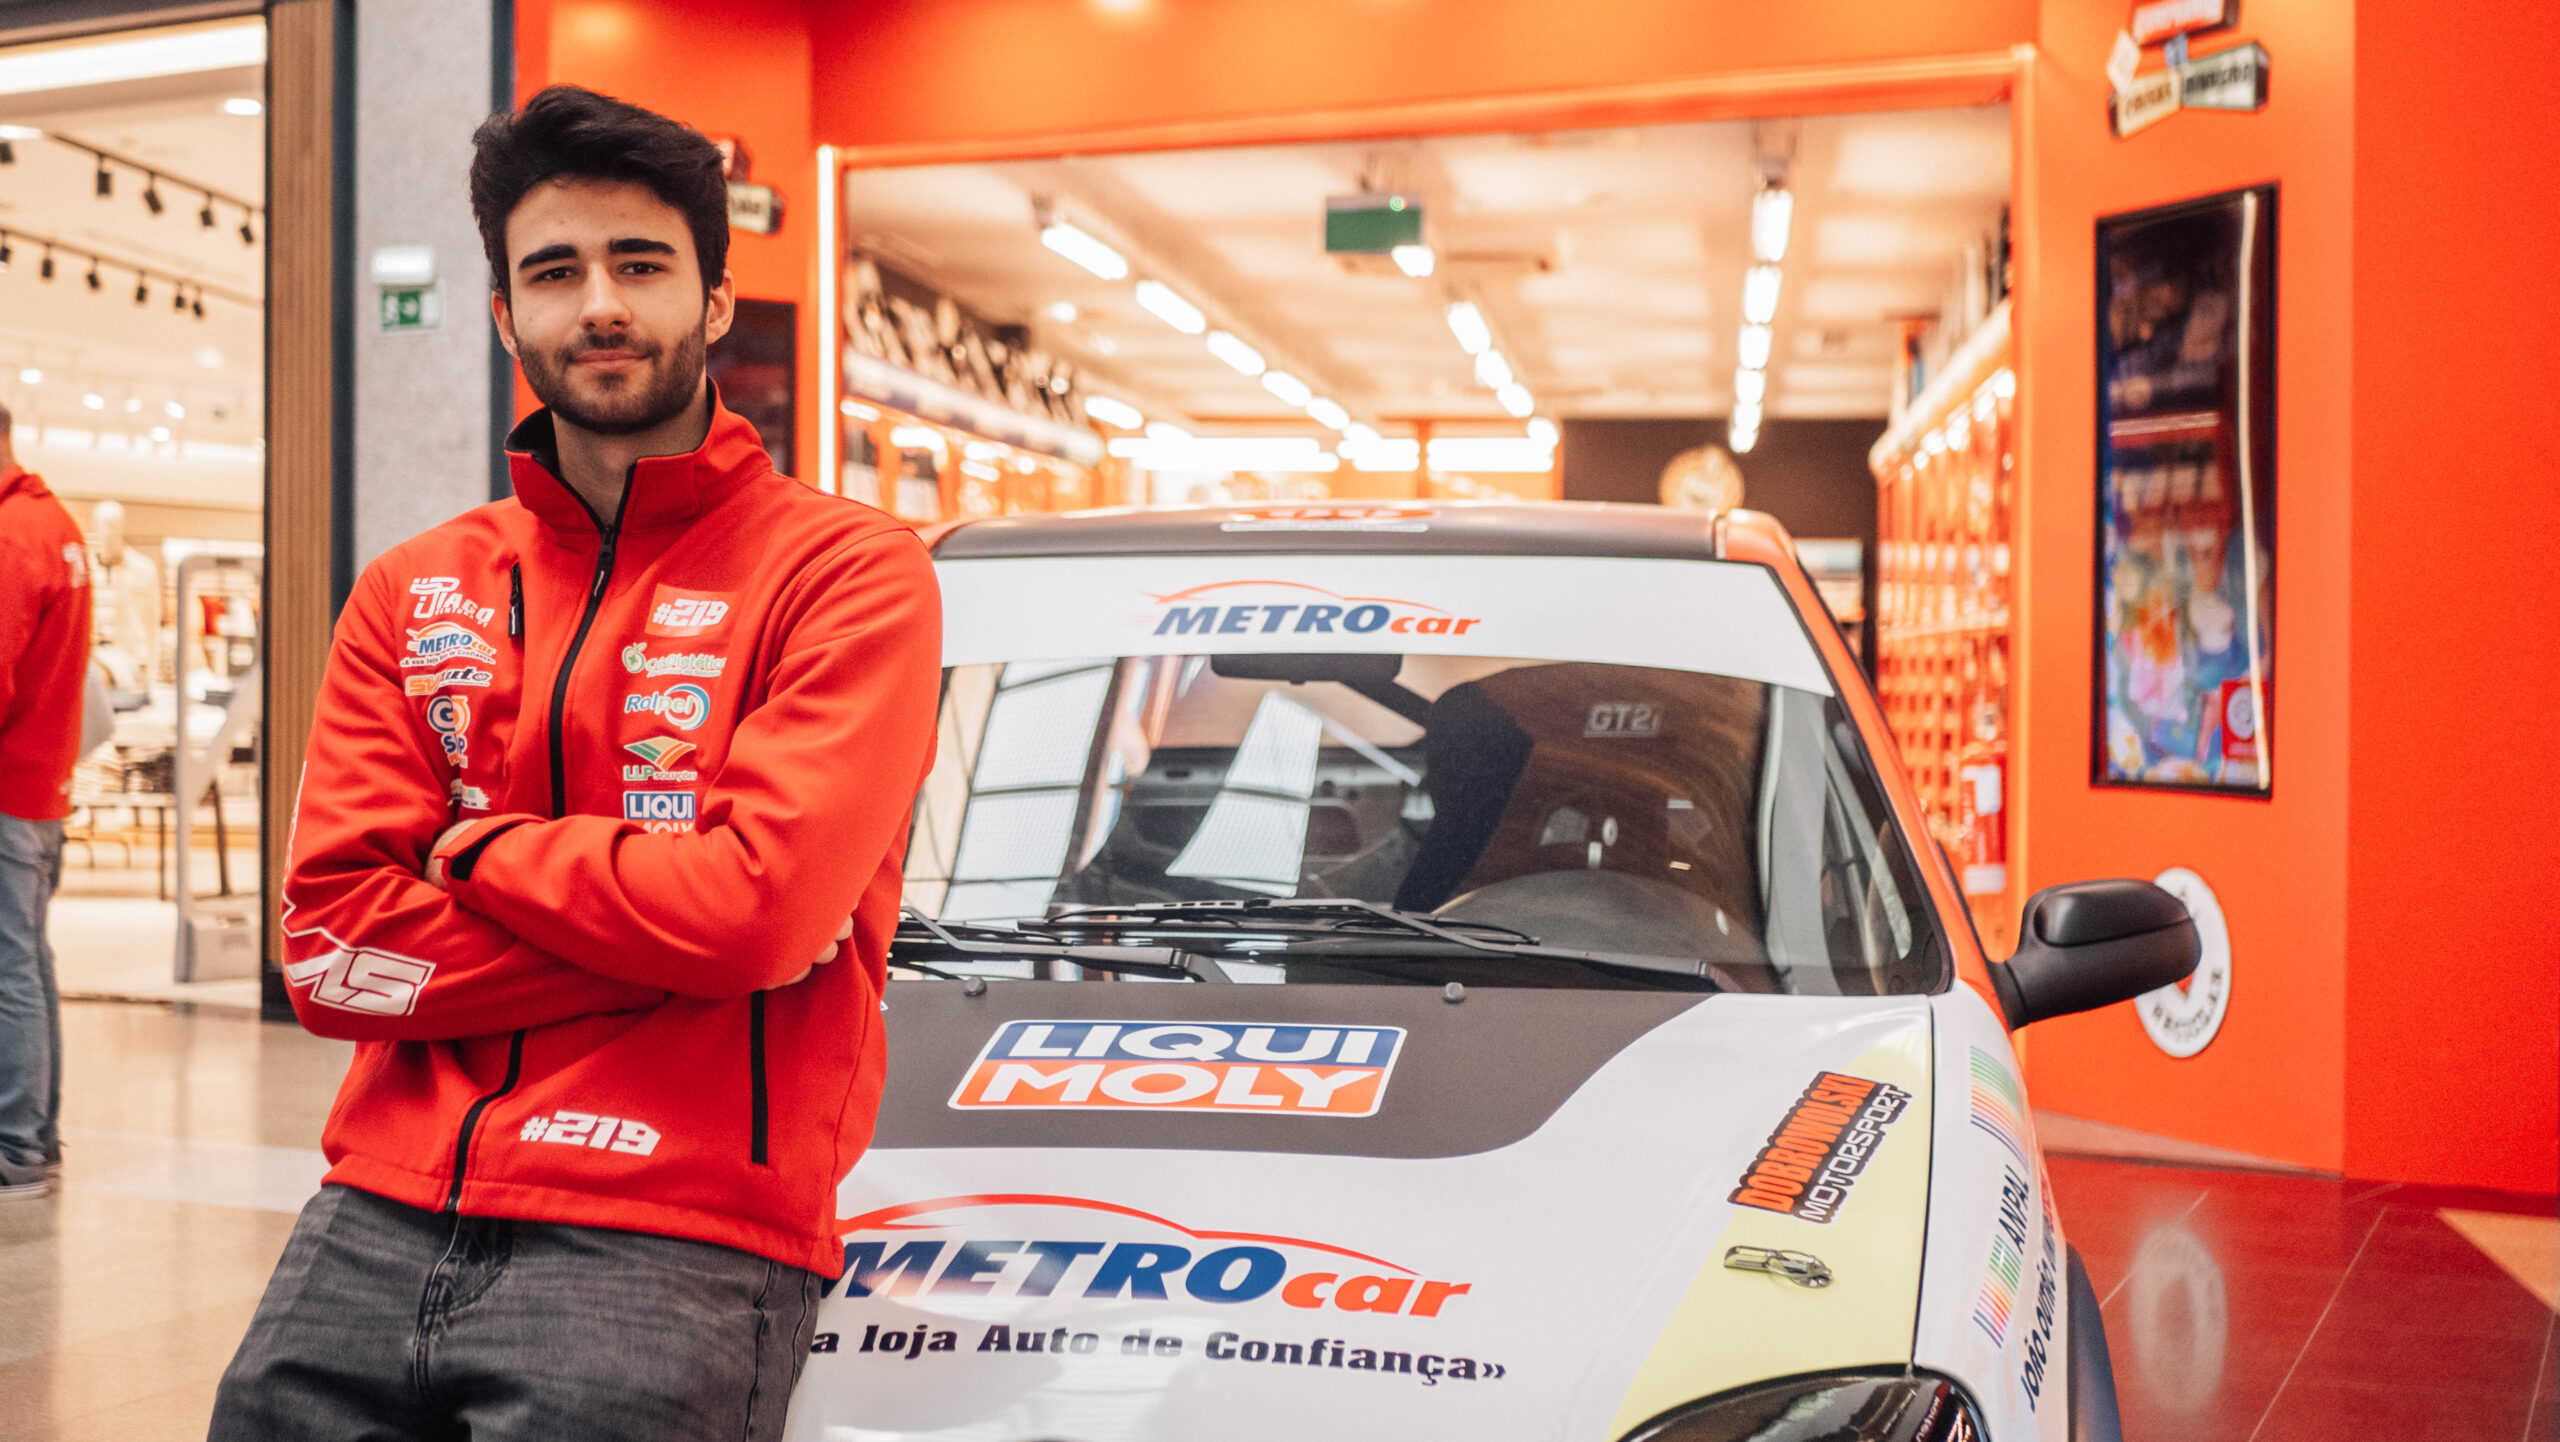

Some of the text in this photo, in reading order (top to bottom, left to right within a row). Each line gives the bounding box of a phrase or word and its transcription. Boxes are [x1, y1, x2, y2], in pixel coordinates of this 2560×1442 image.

[652, 598, 729, 628] #219
[625, 766, 655, 781] LLP
[629, 794, 693, 820] LIQUI
[1008, 1024, 1379, 1062] LIQUI
[979, 1063, 1378, 1109] MOLY
[519, 1110, 662, 1157] #219
[1735, 1073, 1877, 1213] DOBROWOLSKI
[1798, 1084, 1908, 1221] MOTORSPORT
[1998, 1164, 2029, 1255] ANPAL
[859, 1323, 958, 1361] loja
[976, 1324, 1100, 1354] Auto
[1120, 1327, 1184, 1358] de
